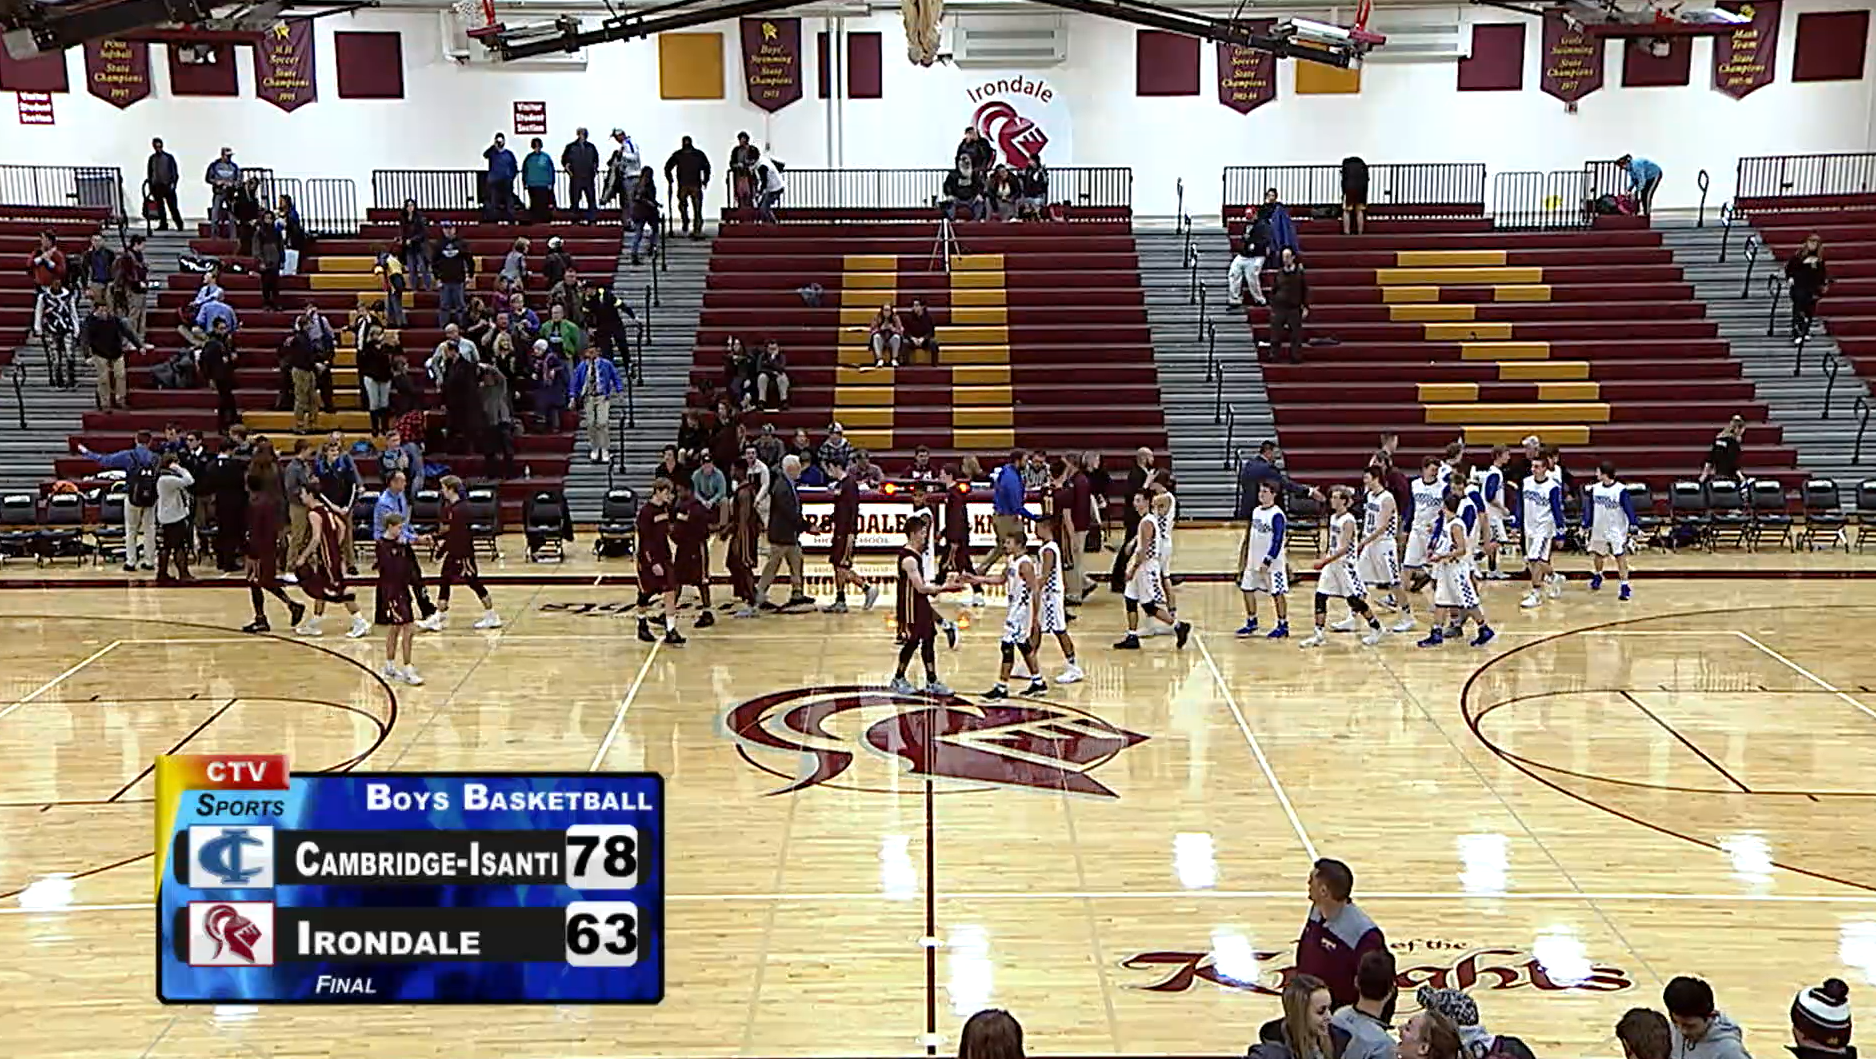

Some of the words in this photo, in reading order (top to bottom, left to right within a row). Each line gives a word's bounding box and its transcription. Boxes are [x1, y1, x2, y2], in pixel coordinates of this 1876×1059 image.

[1732, 40, 1757, 49] Team
[269, 54, 299, 64] Soccer
[1231, 57, 1259, 66] Soccer
[1560, 59, 1582, 67] State
[1731, 54, 1754, 63] State
[106, 63, 130, 73] State
[274, 68, 297, 78] State
[761, 66, 783, 75] State
[1547, 67, 1593, 78] Champions
[1718, 64, 1765, 74] Champions
[94, 72, 143, 84] Champions
[1234, 69, 1256, 78] State
[263, 77, 310, 88] Champions
[750, 75, 793, 86] Champions
[1222, 79, 1267, 89] Champions
[966, 74, 1053, 104] Irondale
[517, 103, 543, 111] Visitor
[516, 113, 545, 122] Student
[517, 124, 545, 132] Section
